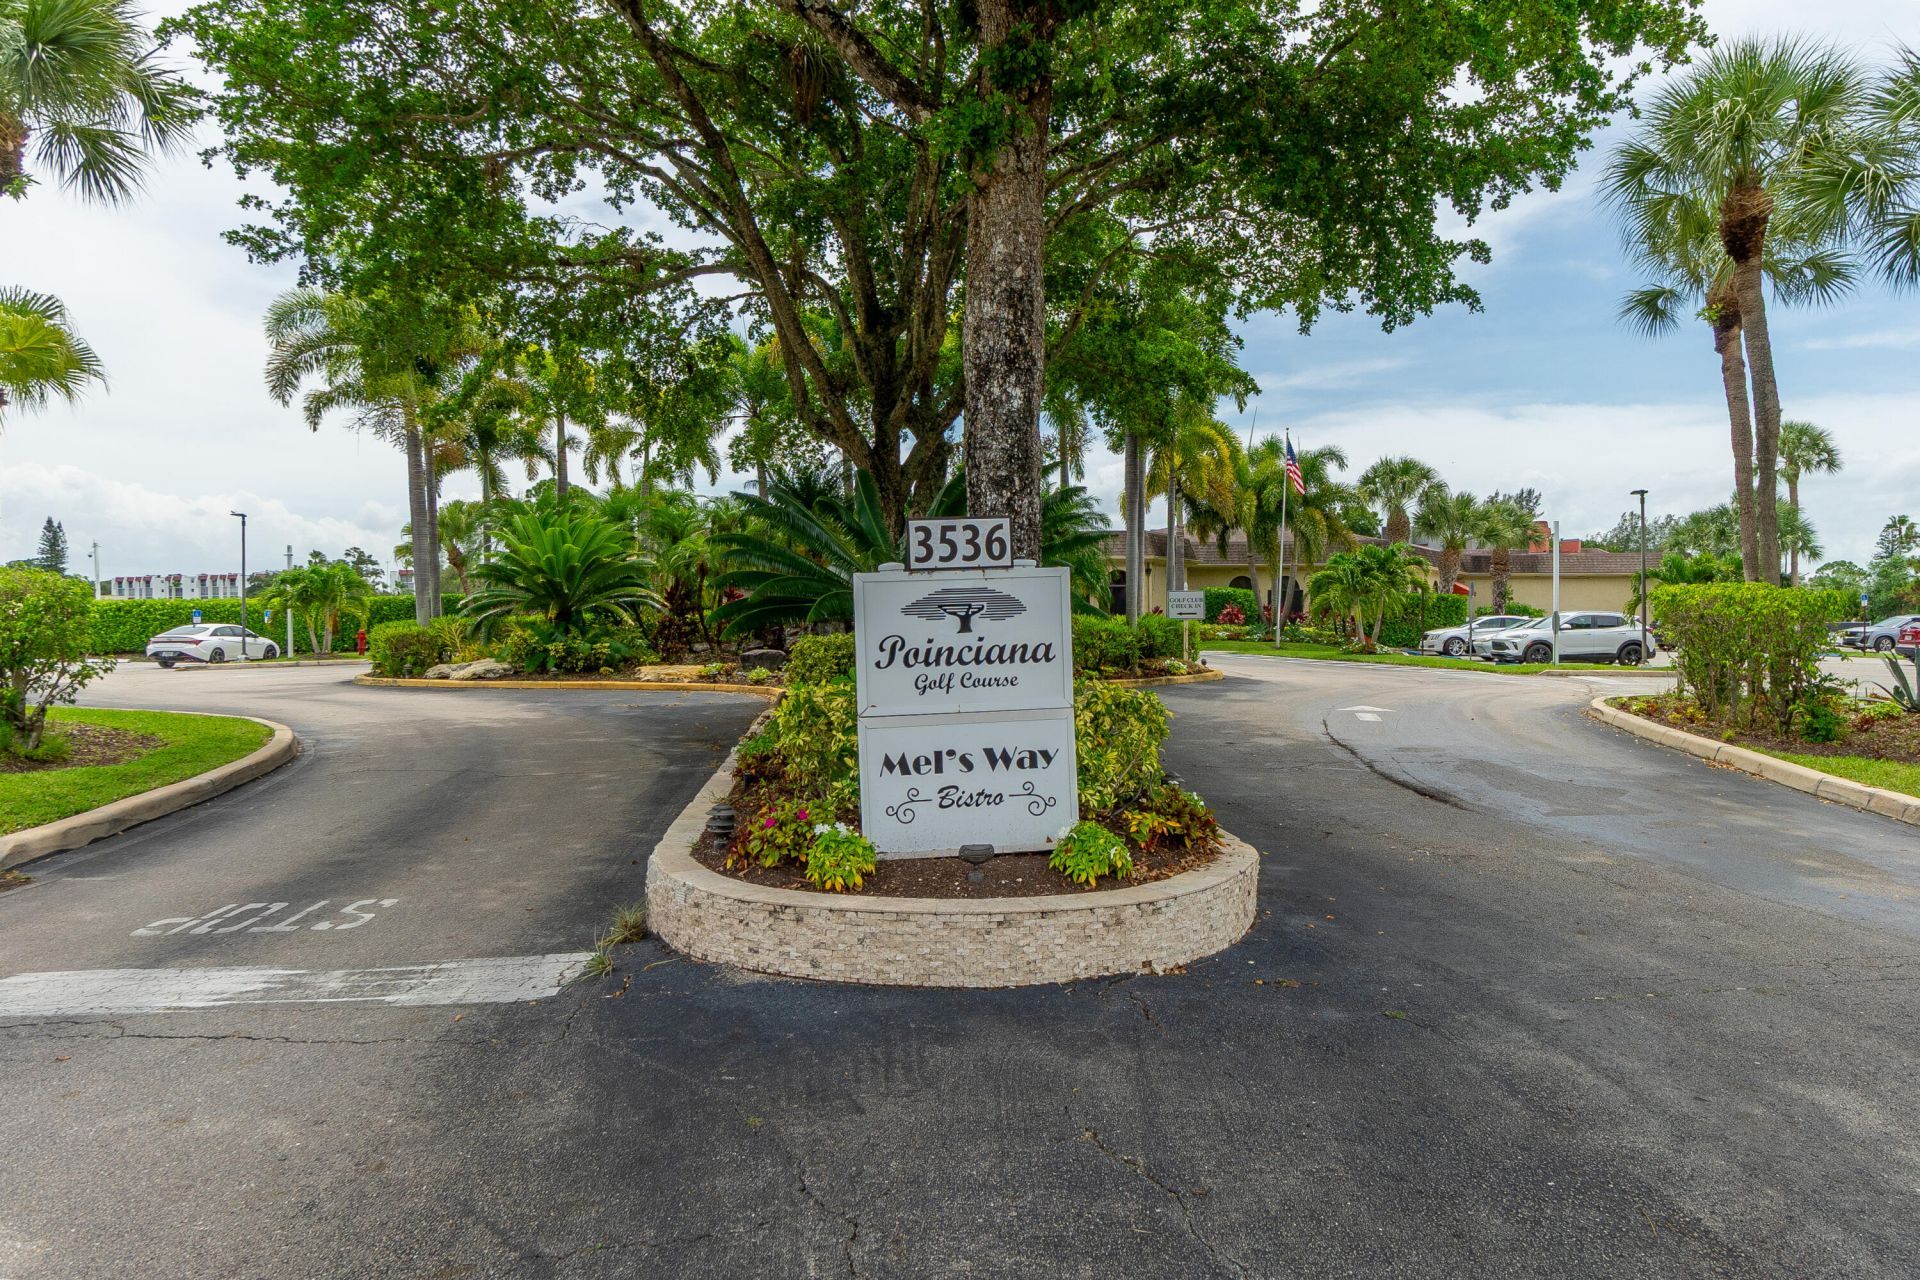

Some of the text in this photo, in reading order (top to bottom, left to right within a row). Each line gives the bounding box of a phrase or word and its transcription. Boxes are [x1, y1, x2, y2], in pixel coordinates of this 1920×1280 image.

[914, 524, 1008, 563] 3536
[874, 635, 1056, 670] Poinciana
[914, 672, 1019, 696] Golf Course
[879, 746, 1059, 777] Mel's Way
[937, 785, 1004, 809] Bistro
